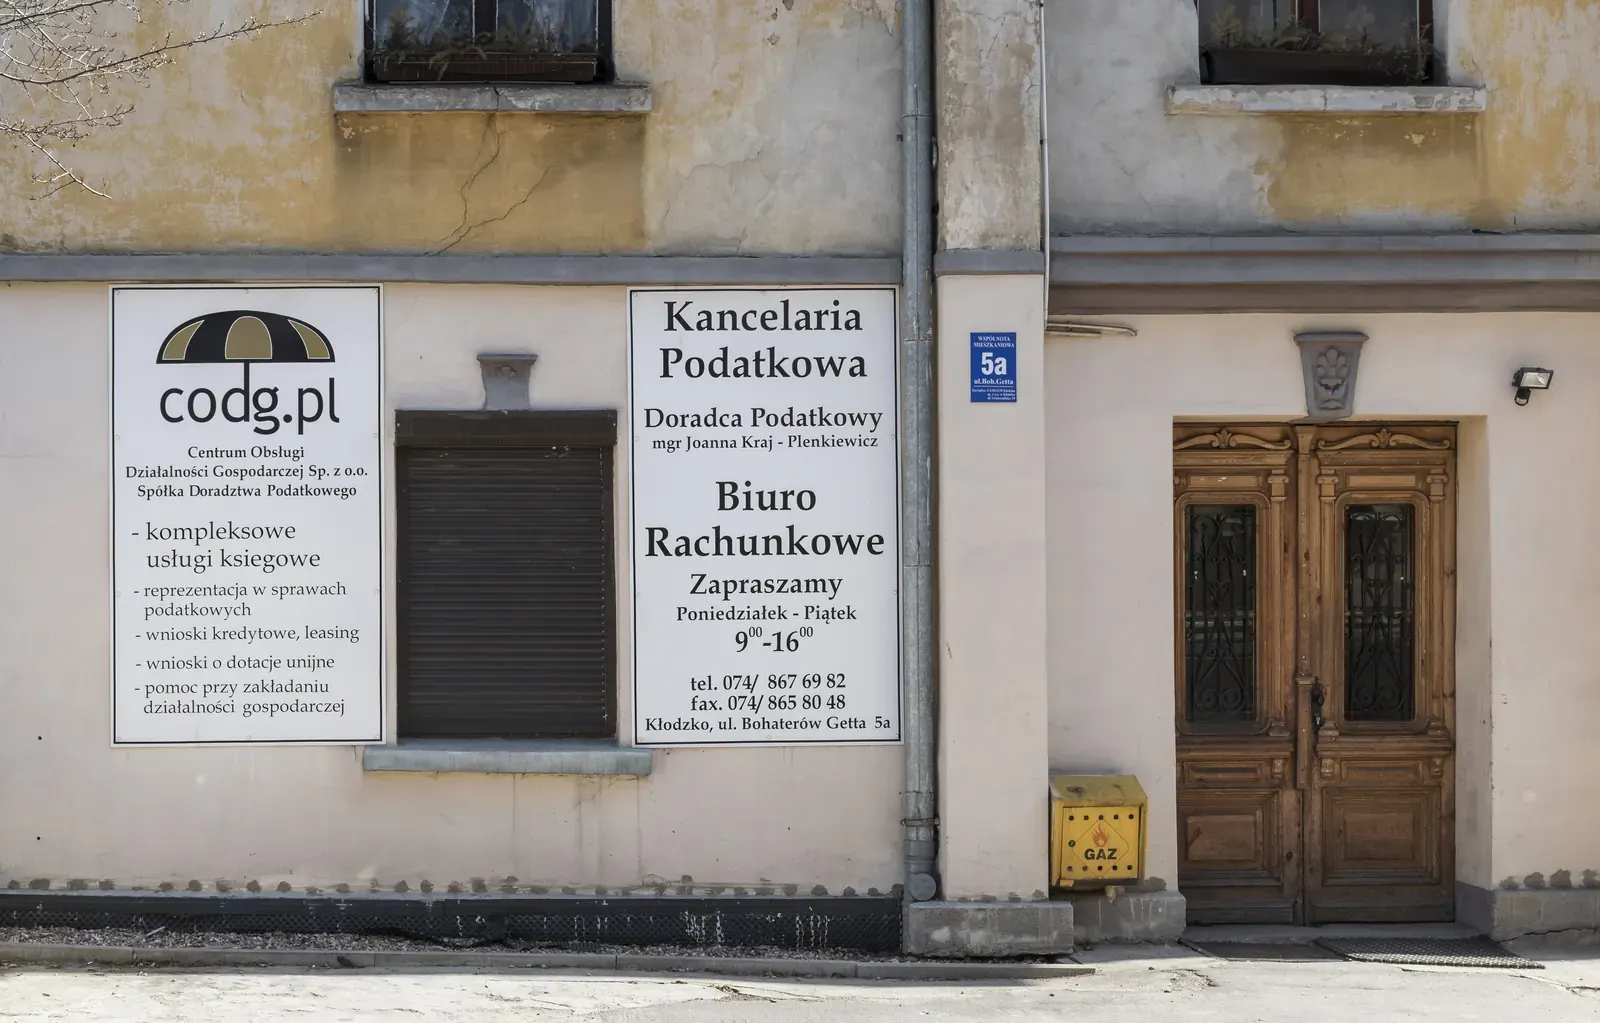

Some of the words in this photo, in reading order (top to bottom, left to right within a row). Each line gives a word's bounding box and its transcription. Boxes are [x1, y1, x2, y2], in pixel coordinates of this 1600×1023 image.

[663, 298, 864, 332] Kancelaria
[659, 345, 868, 379] Podatkowa
[981, 352, 1006, 375] 5a
[159, 377, 340, 436] codg.pl
[643, 406, 743, 428] Doradca
[750, 405, 884, 434] Podatkowy
[187, 446, 247, 459] Centrum
[250, 445, 305, 462] Obsługi
[652, 439, 683, 454] mgr
[685, 436, 738, 453] Joanna
[741, 434, 773, 453] Kraj
[787, 433, 879, 448] Plenkiewicz
[125, 464, 209, 479] Działalności
[212, 464, 304, 481] Gospodarczej
[308, 464, 330, 481] Sp.
[333, 467, 341, 477] z
[344, 467, 368, 477] o.o.
[137, 484, 184, 501] Spółka
[189, 484, 262, 497] Doradztwa
[266, 483, 357, 501] Podatkowego
[715, 480, 817, 512] Biuro
[146, 520, 296, 547] kompleksowe
[644, 523, 885, 558] Rachunkowe
[146, 548, 213, 575] usługi
[219, 548, 321, 574] ksiegowe
[144, 582, 248, 602] reprezentacja
[252, 586, 267, 596] w
[271, 581, 346, 600] sprawach
[689, 573, 844, 602] Zapraszamy
[144, 602, 251, 621] podatkowych
[676, 604, 789, 622] Poniedziałek
[803, 604, 857, 625] Piątek
[145, 626, 207, 641] wnioski
[212, 625, 300, 645] kredytowe,
[304, 625, 360, 644] leasing
[146, 655, 208, 670] wnioski
[212, 659, 222, 669] o
[226, 654, 282, 673] dotacje
[286, 654, 335, 673] unijne
[145, 683, 198, 699] pomoc
[202, 683, 238, 698] przy
[243, 679, 329, 694] zakładaniu
[690, 674, 718, 692] tel.
[722, 673, 760, 694] 074/
[767, 673, 798, 690] 867
[802, 673, 822, 689] 69
[826, 672, 846, 689] 82
[143, 699, 235, 714] działalności
[242, 698, 345, 718] gospodarczej
[690, 694, 723, 711] fax.
[727, 694, 765, 715] 074/
[767, 694, 797, 711] 865
[801, 694, 822, 710] 80
[825, 693, 846, 710] 48
[645, 717, 714, 733] Kłodzko,
[717, 716, 737, 731] ul.
[741, 716, 822, 730] Bohaterów
[826, 716, 867, 730] Getta
[874, 715, 892, 729] 5a
[1084, 848, 1118, 861] GAZ
